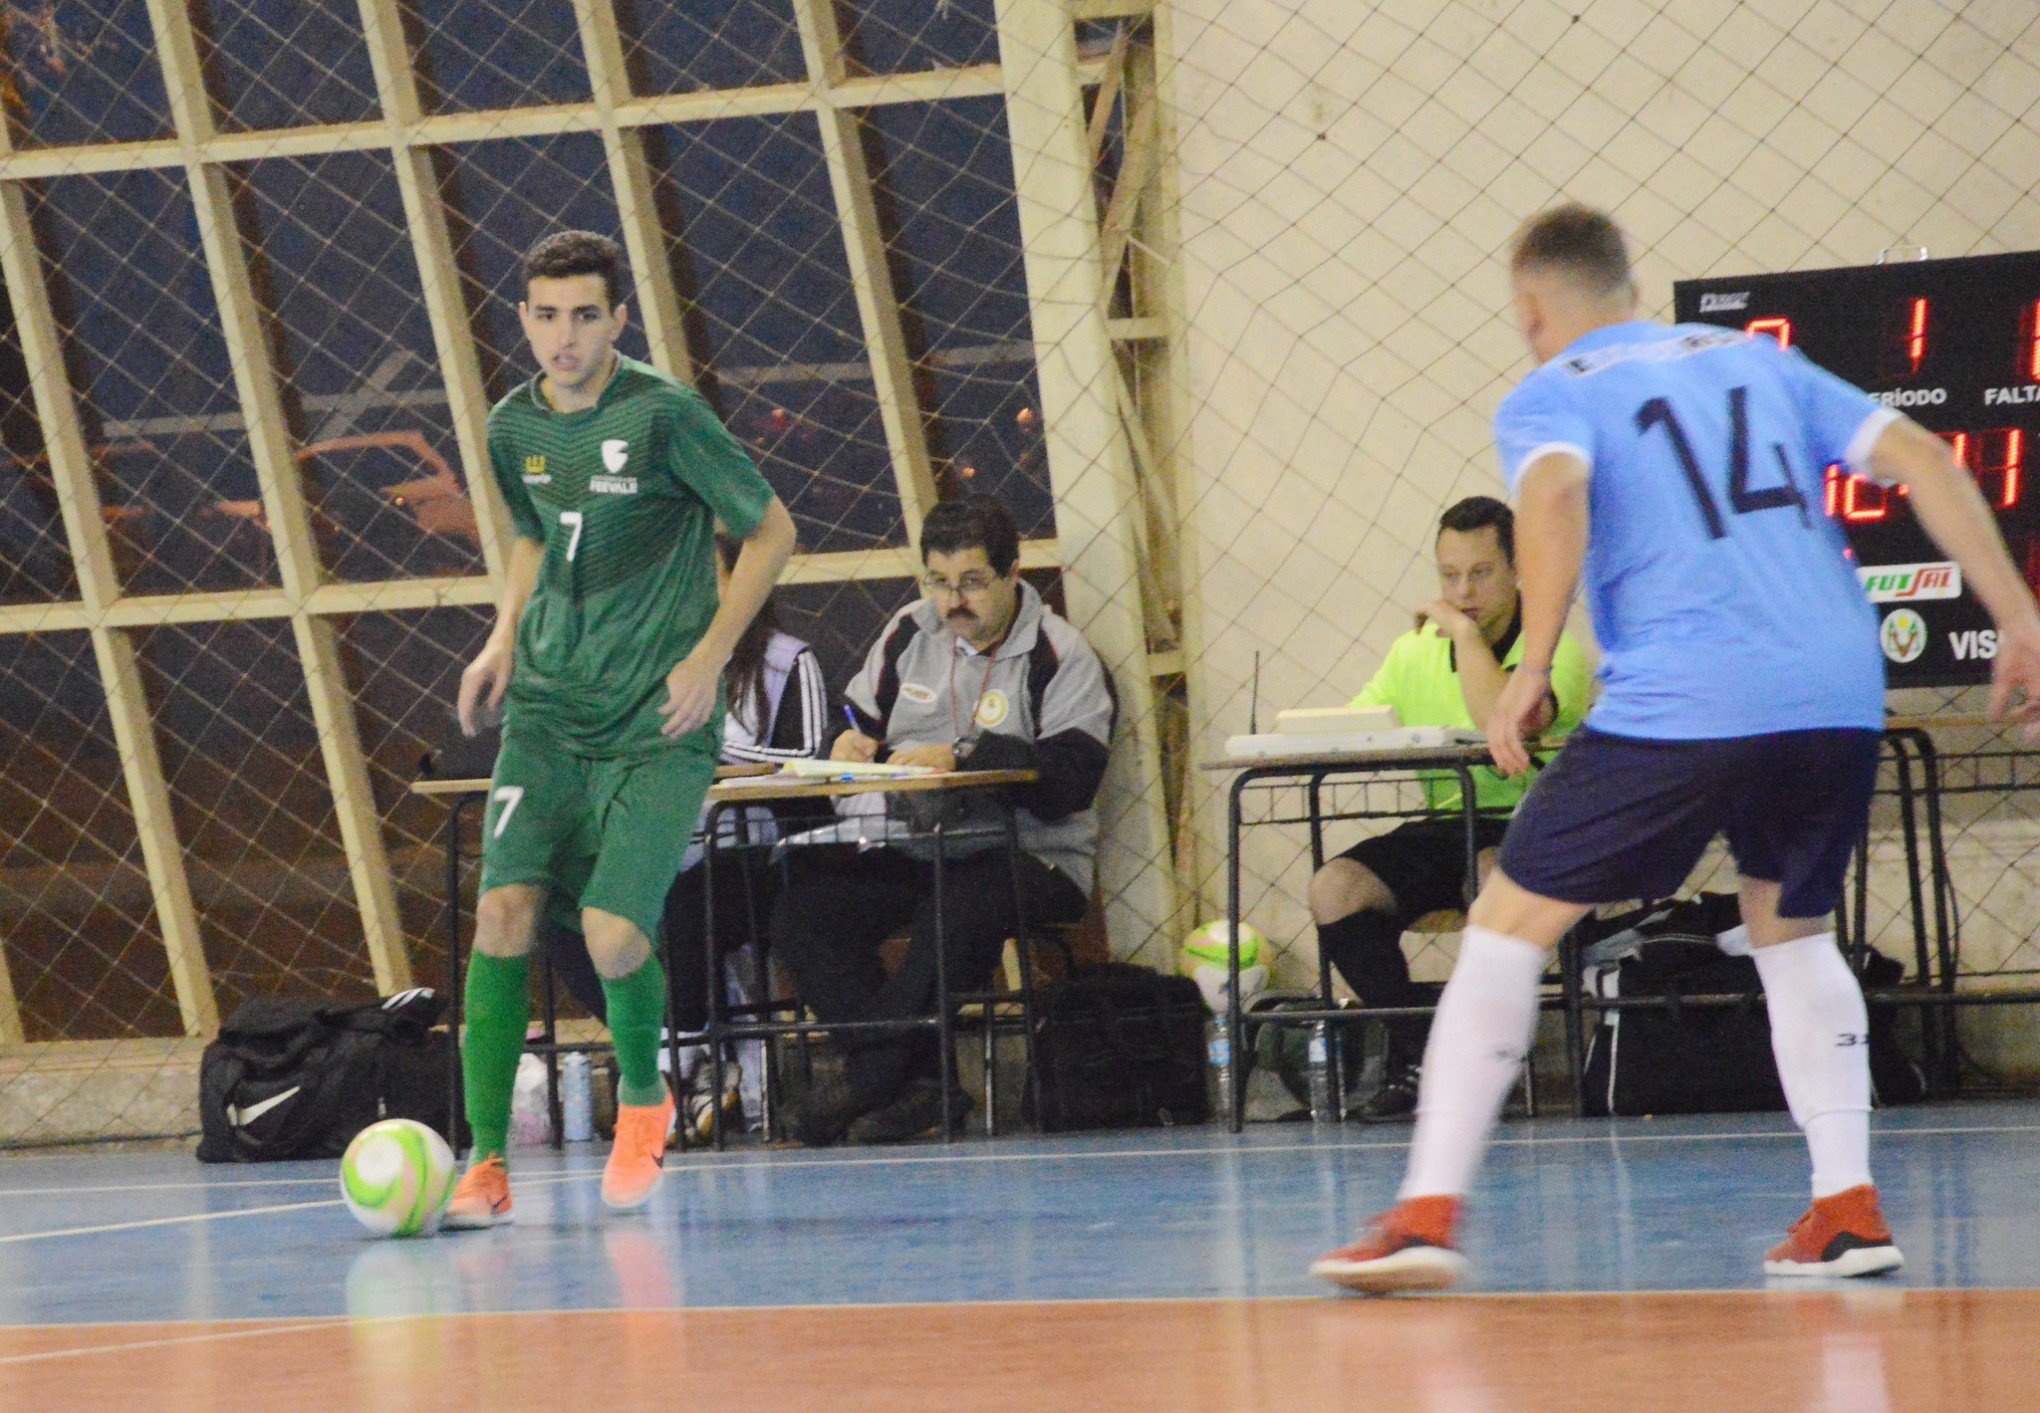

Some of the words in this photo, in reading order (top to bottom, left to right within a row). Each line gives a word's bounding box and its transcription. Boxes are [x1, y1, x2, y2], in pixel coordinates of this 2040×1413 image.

[1633, 385, 1812, 540] 14
[559, 511, 583, 562] 7
[1948, 629, 1998, 660] VIS
[493, 785, 524, 840] 7
